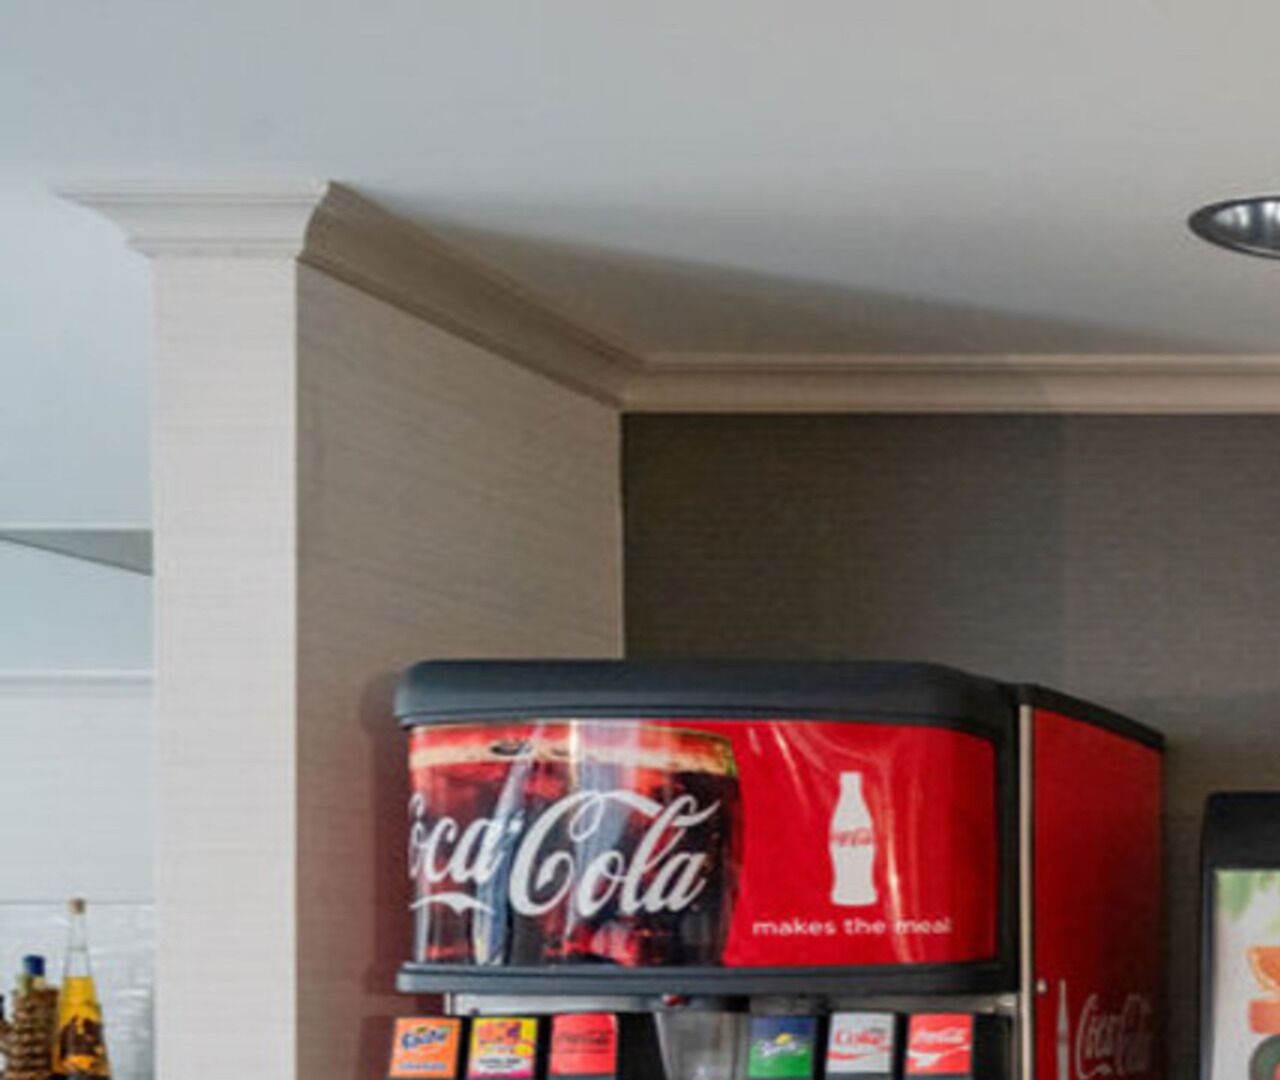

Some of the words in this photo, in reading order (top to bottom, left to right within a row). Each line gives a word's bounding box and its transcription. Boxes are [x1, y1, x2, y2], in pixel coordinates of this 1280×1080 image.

[752, 917, 836, 936] makes
[843, 917, 886, 934] the
[894, 917, 953, 934] meal
